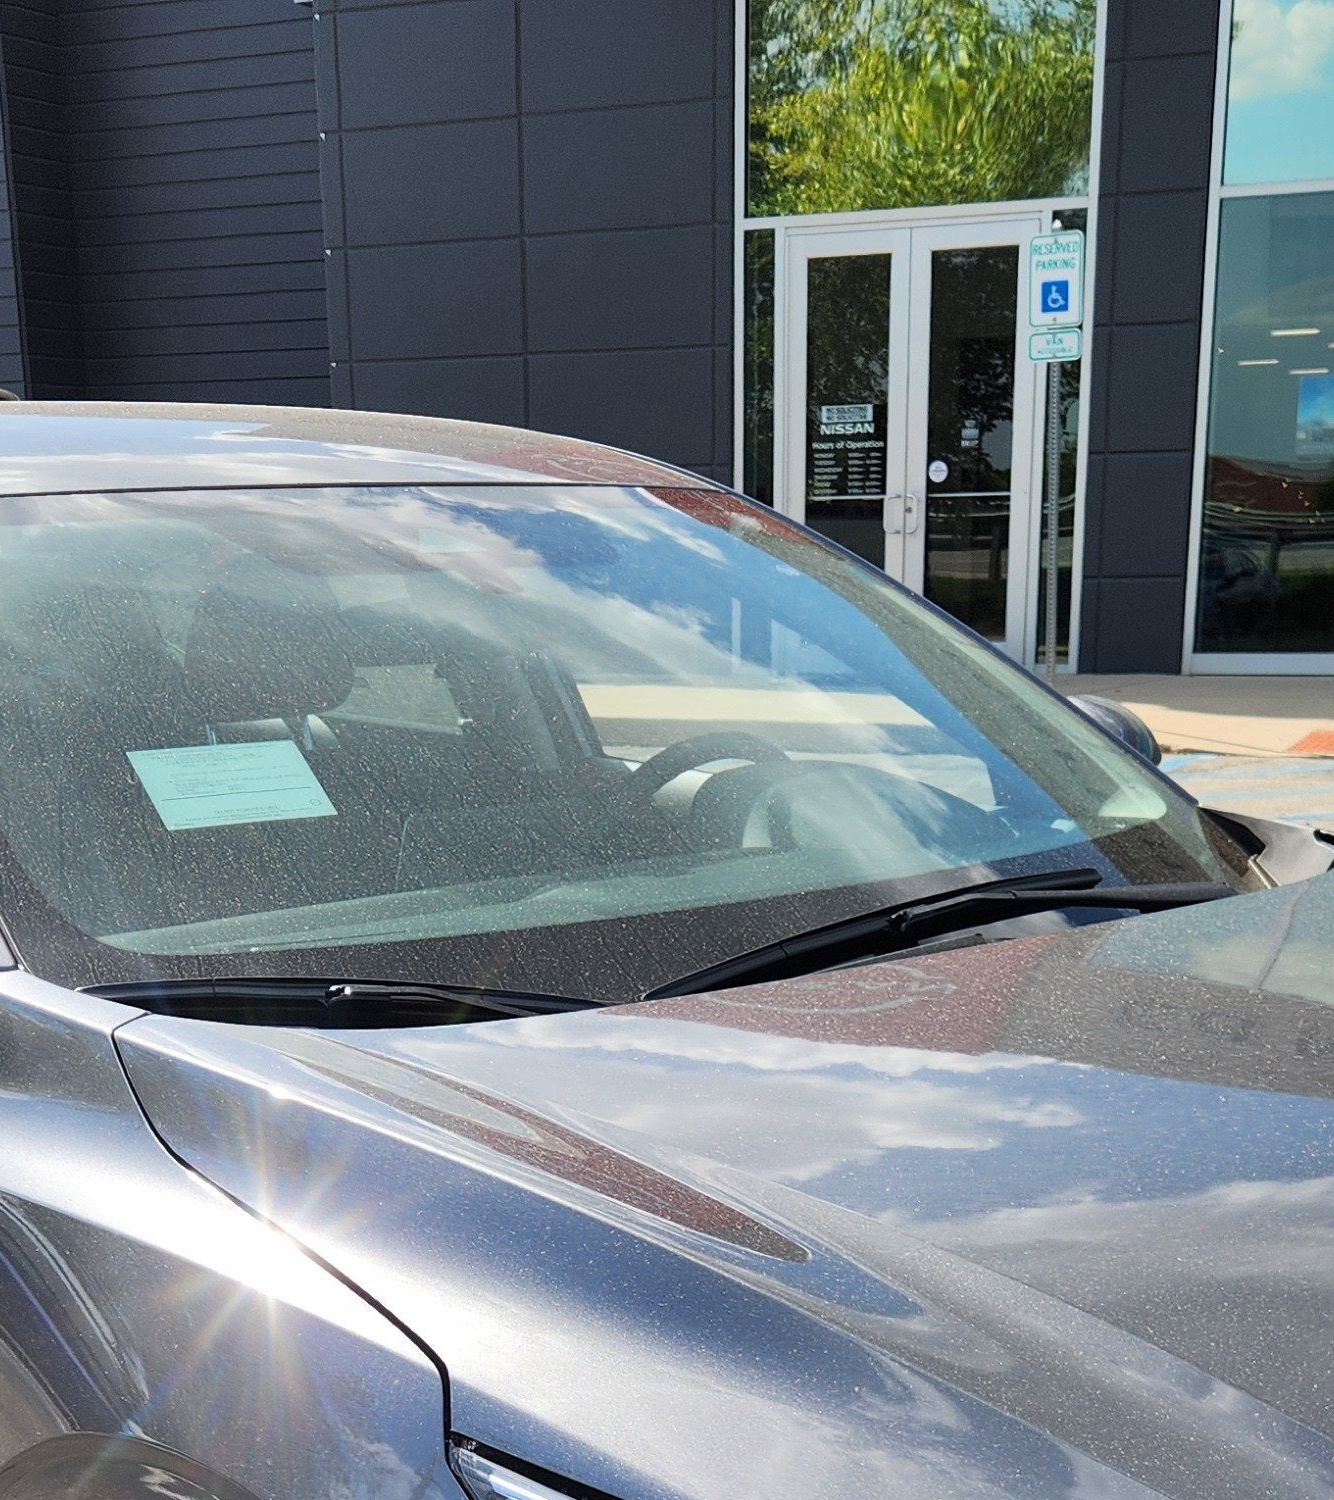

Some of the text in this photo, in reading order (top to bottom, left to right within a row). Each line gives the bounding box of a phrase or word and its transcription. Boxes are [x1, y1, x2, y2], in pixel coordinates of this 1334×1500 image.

[1032, 241, 1080, 256] RESERVED
[1035, 257, 1076, 271] PARKING
[1045, 335, 1064, 347] VAN
[820, 423, 875, 435] NISSAN
[812, 442, 835, 450] Hours
[845, 440, 885, 450] Operation
